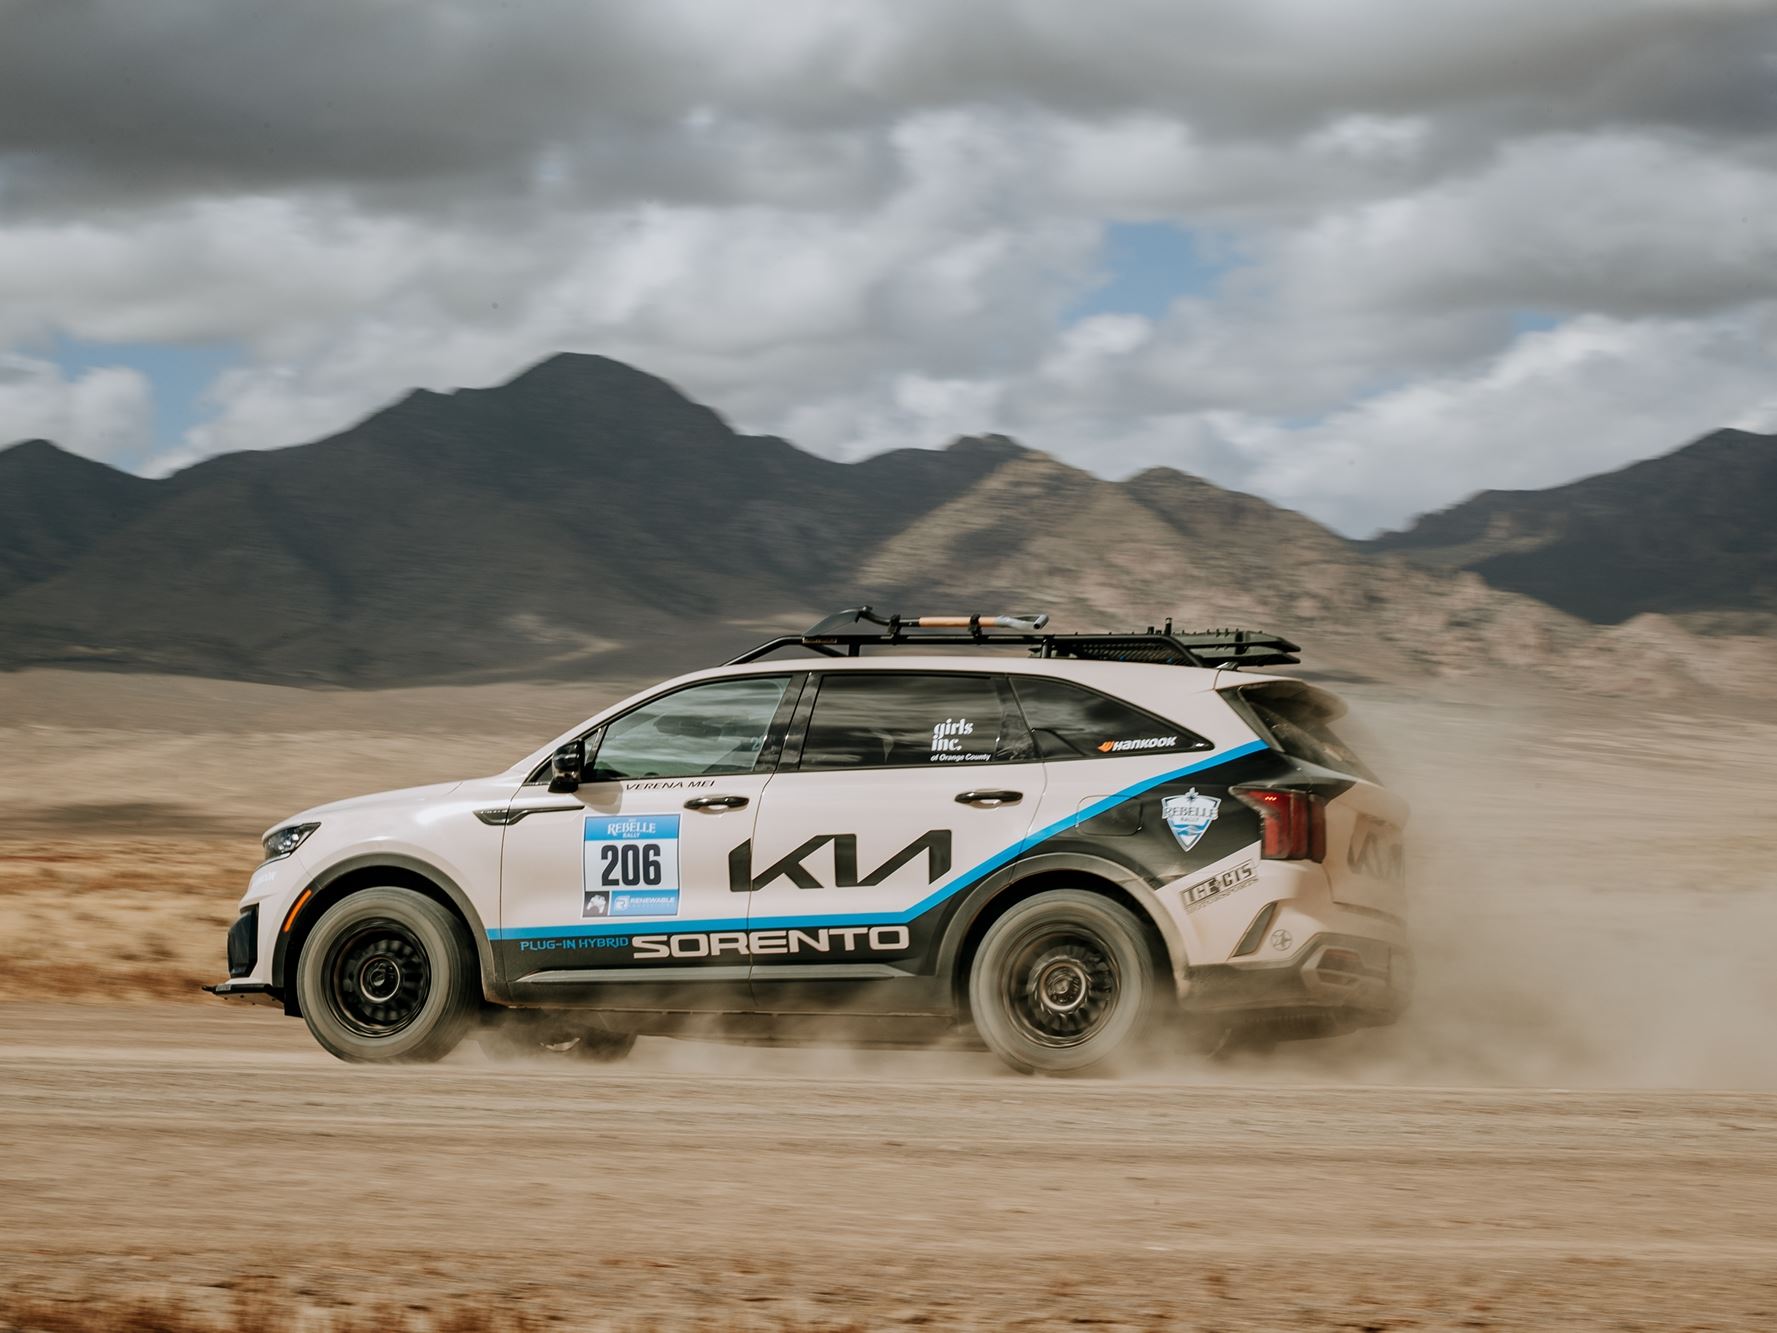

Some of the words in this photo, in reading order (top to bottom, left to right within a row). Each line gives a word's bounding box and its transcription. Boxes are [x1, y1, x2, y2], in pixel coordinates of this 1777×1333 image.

[933, 718, 974, 739] girls
[930, 753, 940, 762] of
[939, 753, 965, 763] Orange
[965, 753, 992, 762] County
[626, 782, 684, 791] VERENA
[688, 780, 715, 788] MEI
[607, 821, 657, 836] REBELLE
[601, 843, 662, 886] 206
[728, 829, 952, 892] KIA
[520, 939, 576, 951] PLUG-IN
[579, 937, 629, 949] HYBRID
[632, 925, 910, 959] SORENTO
